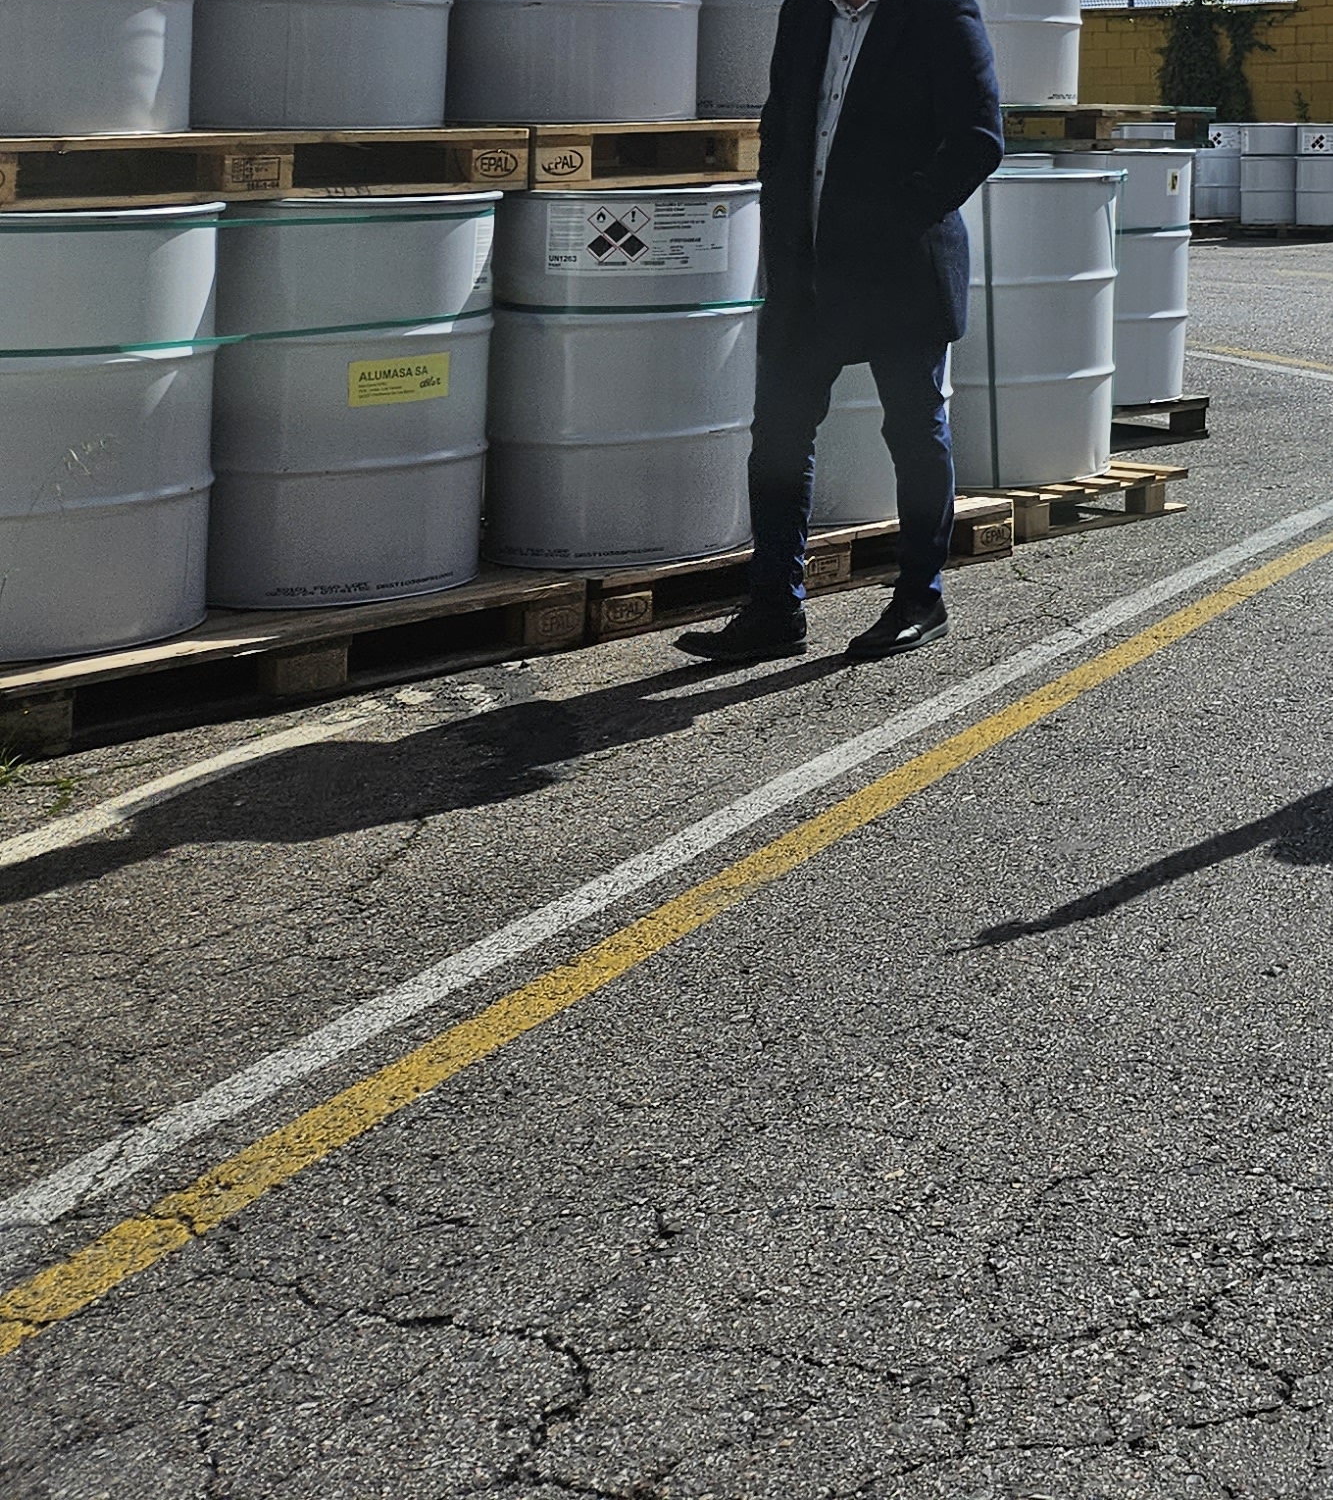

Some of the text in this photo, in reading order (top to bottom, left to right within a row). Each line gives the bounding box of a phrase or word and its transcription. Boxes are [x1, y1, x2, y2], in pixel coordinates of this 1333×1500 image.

[480, 156, 511, 172] EPAL
[548, 255, 577, 263] UN1263
[358, 365, 429, 382] ALUMASA SA
